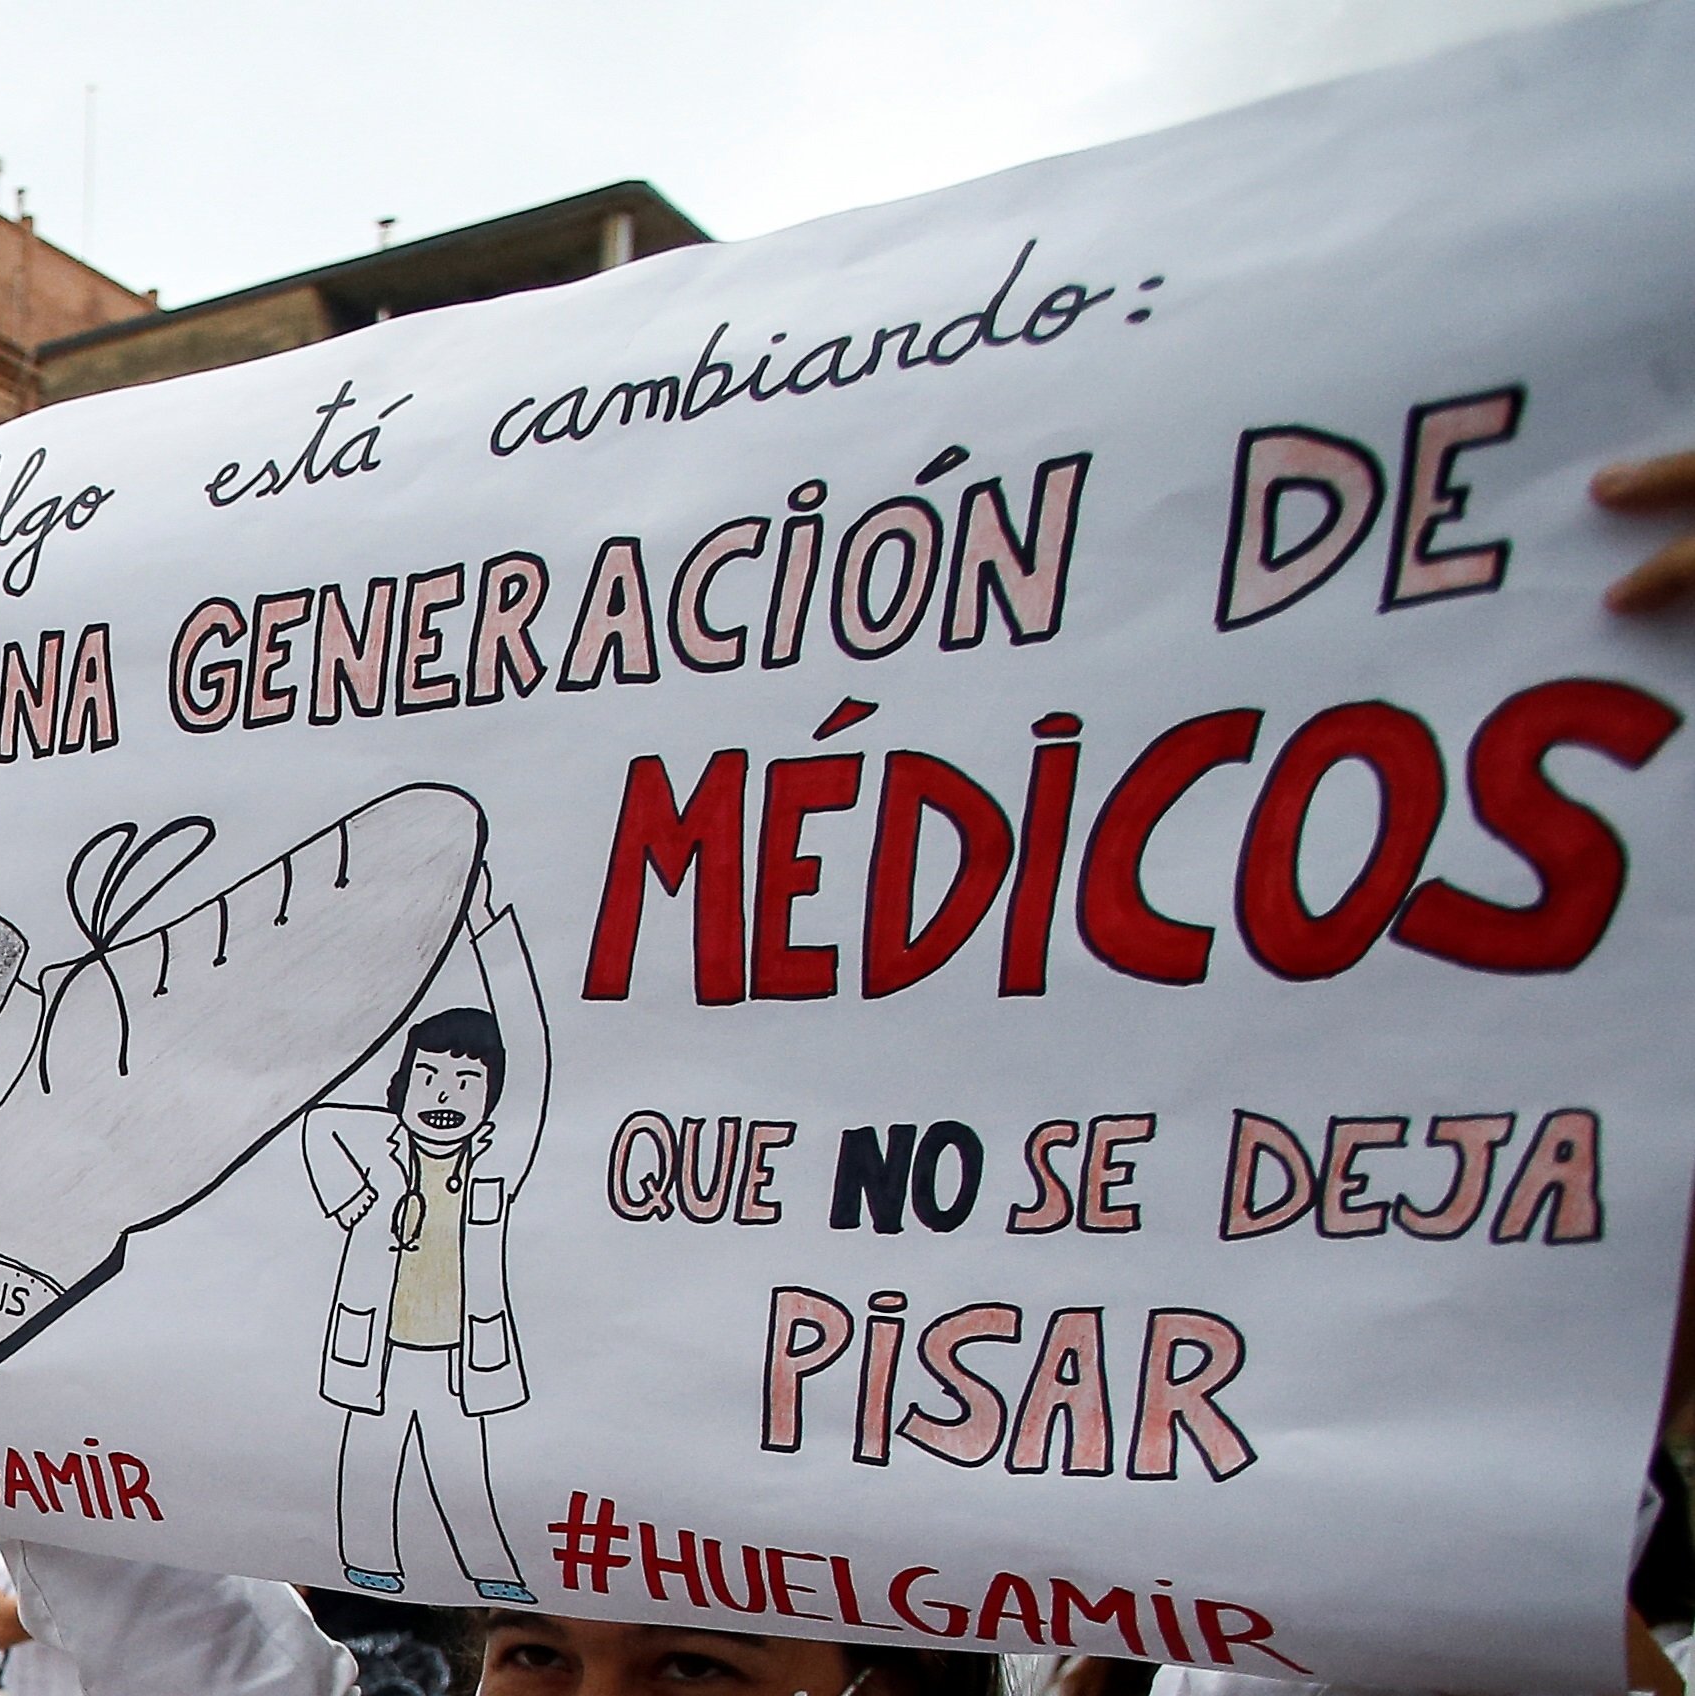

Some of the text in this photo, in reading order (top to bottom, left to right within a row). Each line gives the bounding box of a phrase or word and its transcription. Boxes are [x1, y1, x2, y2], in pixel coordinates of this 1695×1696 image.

[207, 378, 415, 510] está
[490, 239, 1166, 458] cambiando:
[170, 444, 1092, 736] GENERACIÓN
[1215, 386, 1526, 634] DE
[581, 677, 1685, 1008] MÉDICOS
[607, 1106, 1605, 1246] QUE NO SE DEJA
[760, 1284, 1259, 1485] PISAR
[547, 1489, 1313, 1676] #HUELGAMIR
